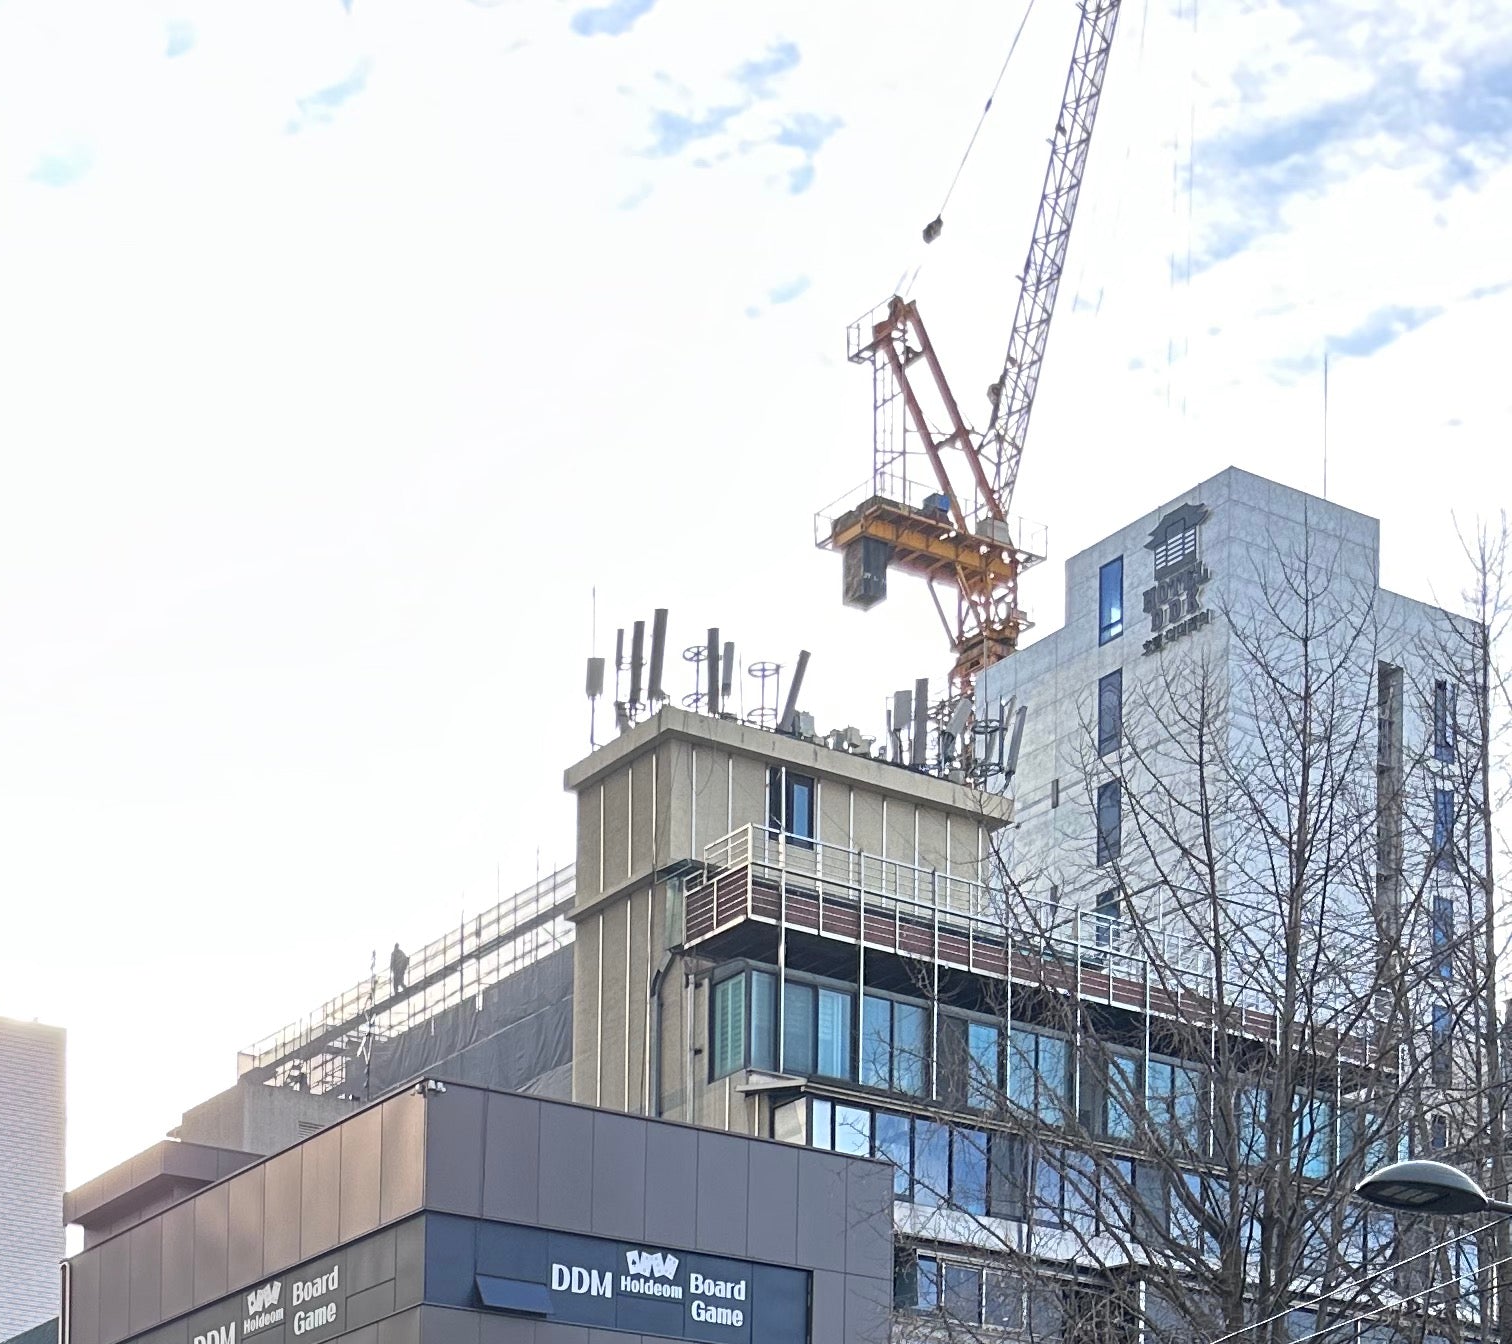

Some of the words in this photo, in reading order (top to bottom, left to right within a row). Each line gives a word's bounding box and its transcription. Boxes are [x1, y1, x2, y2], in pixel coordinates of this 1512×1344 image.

[292, 1265, 338, 1306] Board
[551, 1263, 613, 1298] DDM
[620, 1275, 683, 1299] Holdeom
[689, 1273, 746, 1300] Board
[243, 1307, 284, 1334] Holdeom
[293, 1302, 337, 1336] Game
[691, 1300, 743, 1327] Game
